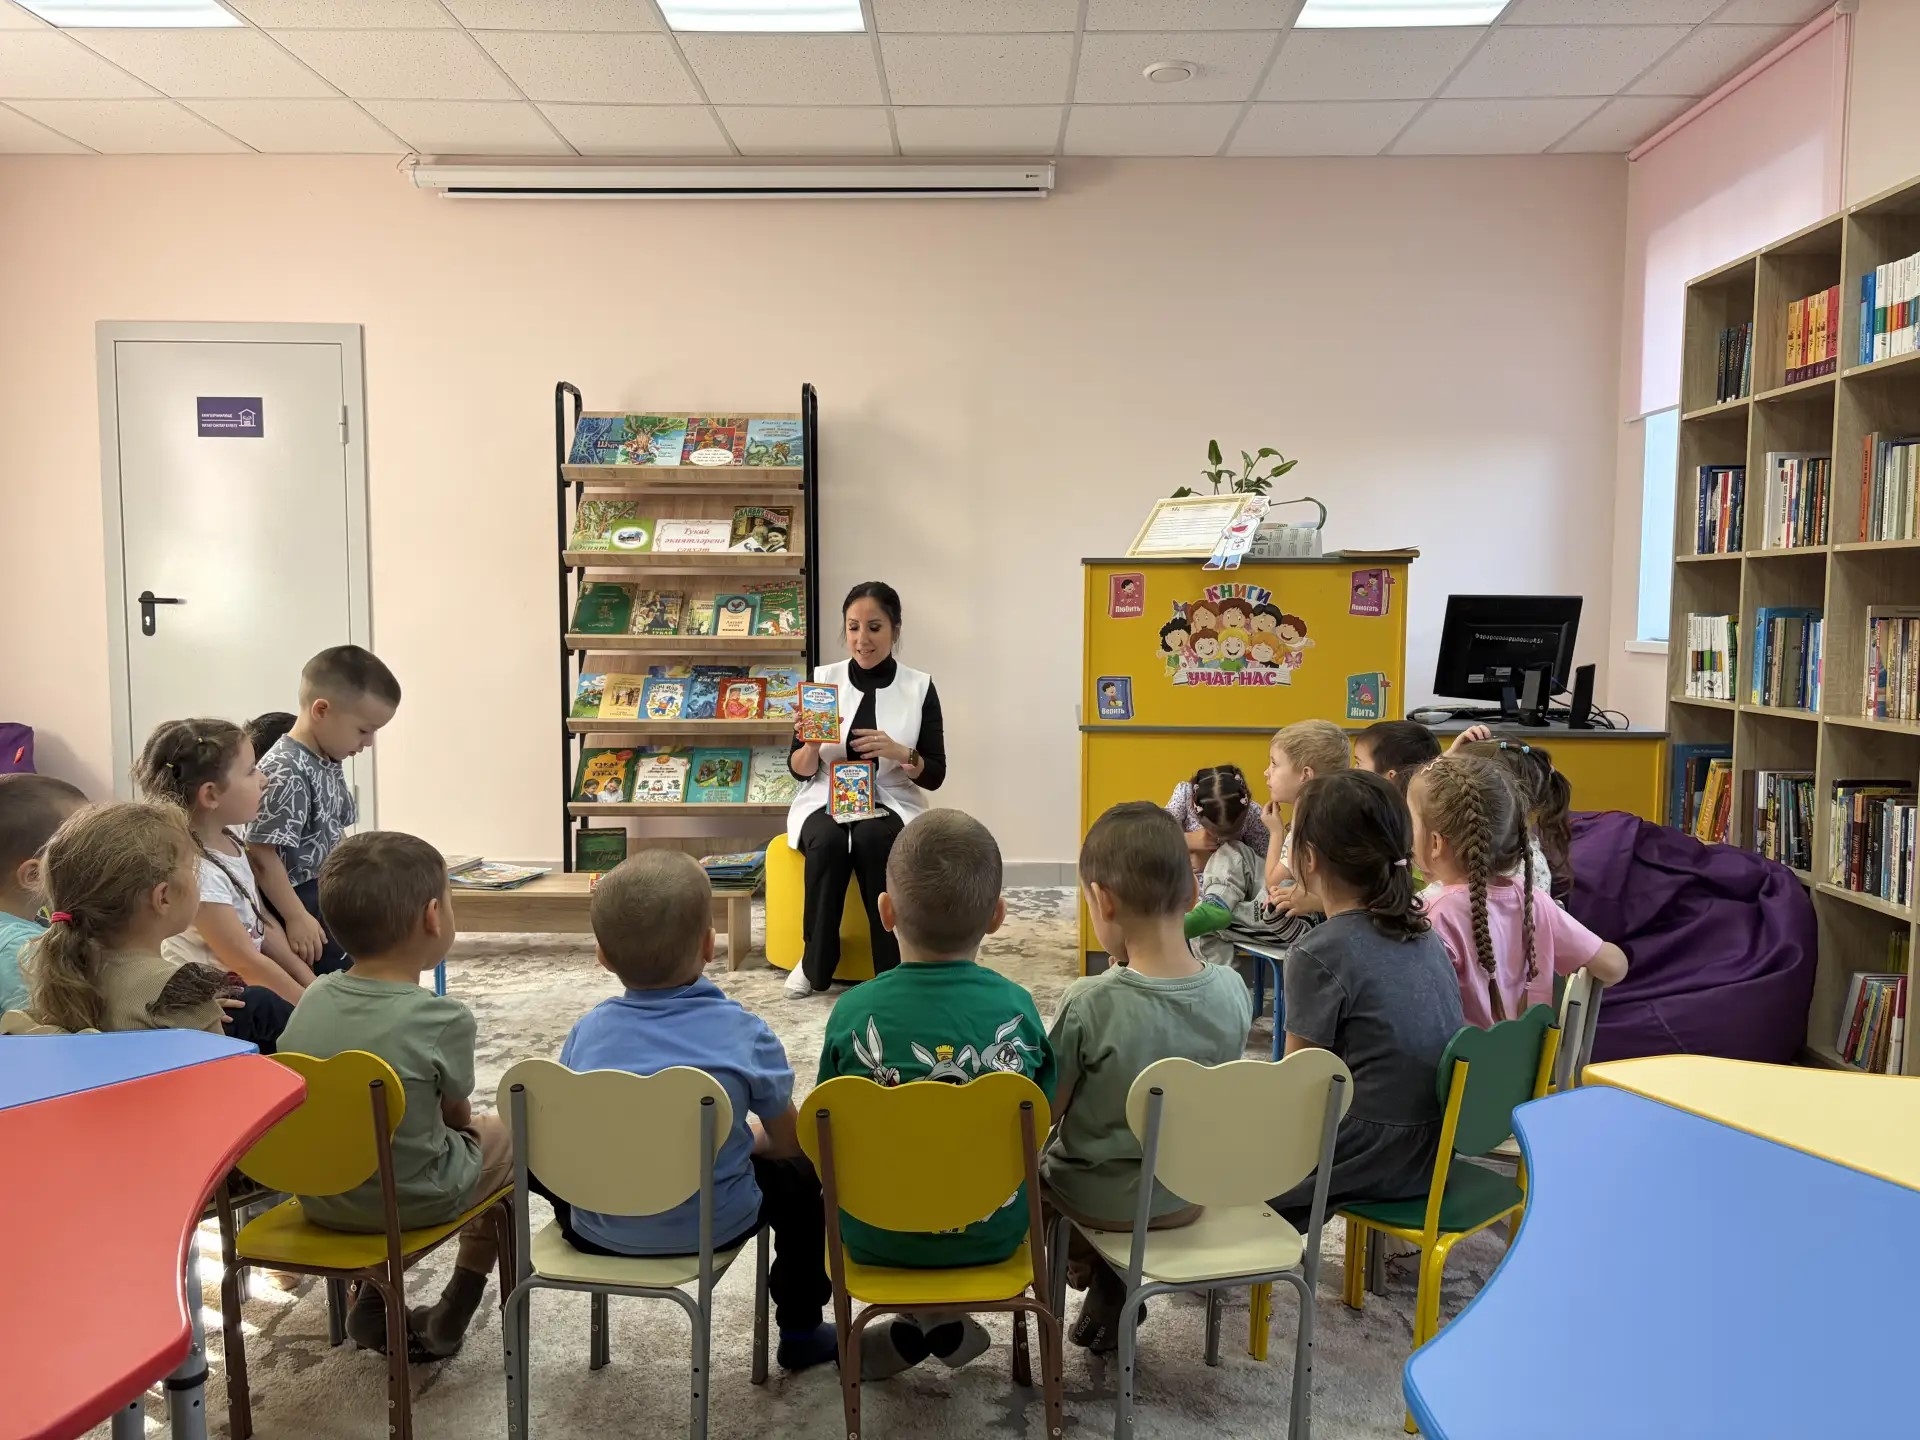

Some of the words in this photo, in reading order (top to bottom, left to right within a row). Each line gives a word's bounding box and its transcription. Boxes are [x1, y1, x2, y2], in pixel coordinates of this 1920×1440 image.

[683, 527, 711, 536] Тукай
[1204, 583, 1273, 605] КНИГИ
[1115, 605, 1142, 614] Любить
[1351, 603, 1379, 613] Помогать
[1186, 670, 1235, 687] УЧАТ
[1240, 671, 1278, 687] НАС
[1101, 706, 1125, 716] Верить
[1349, 707, 1375, 719] Жить
